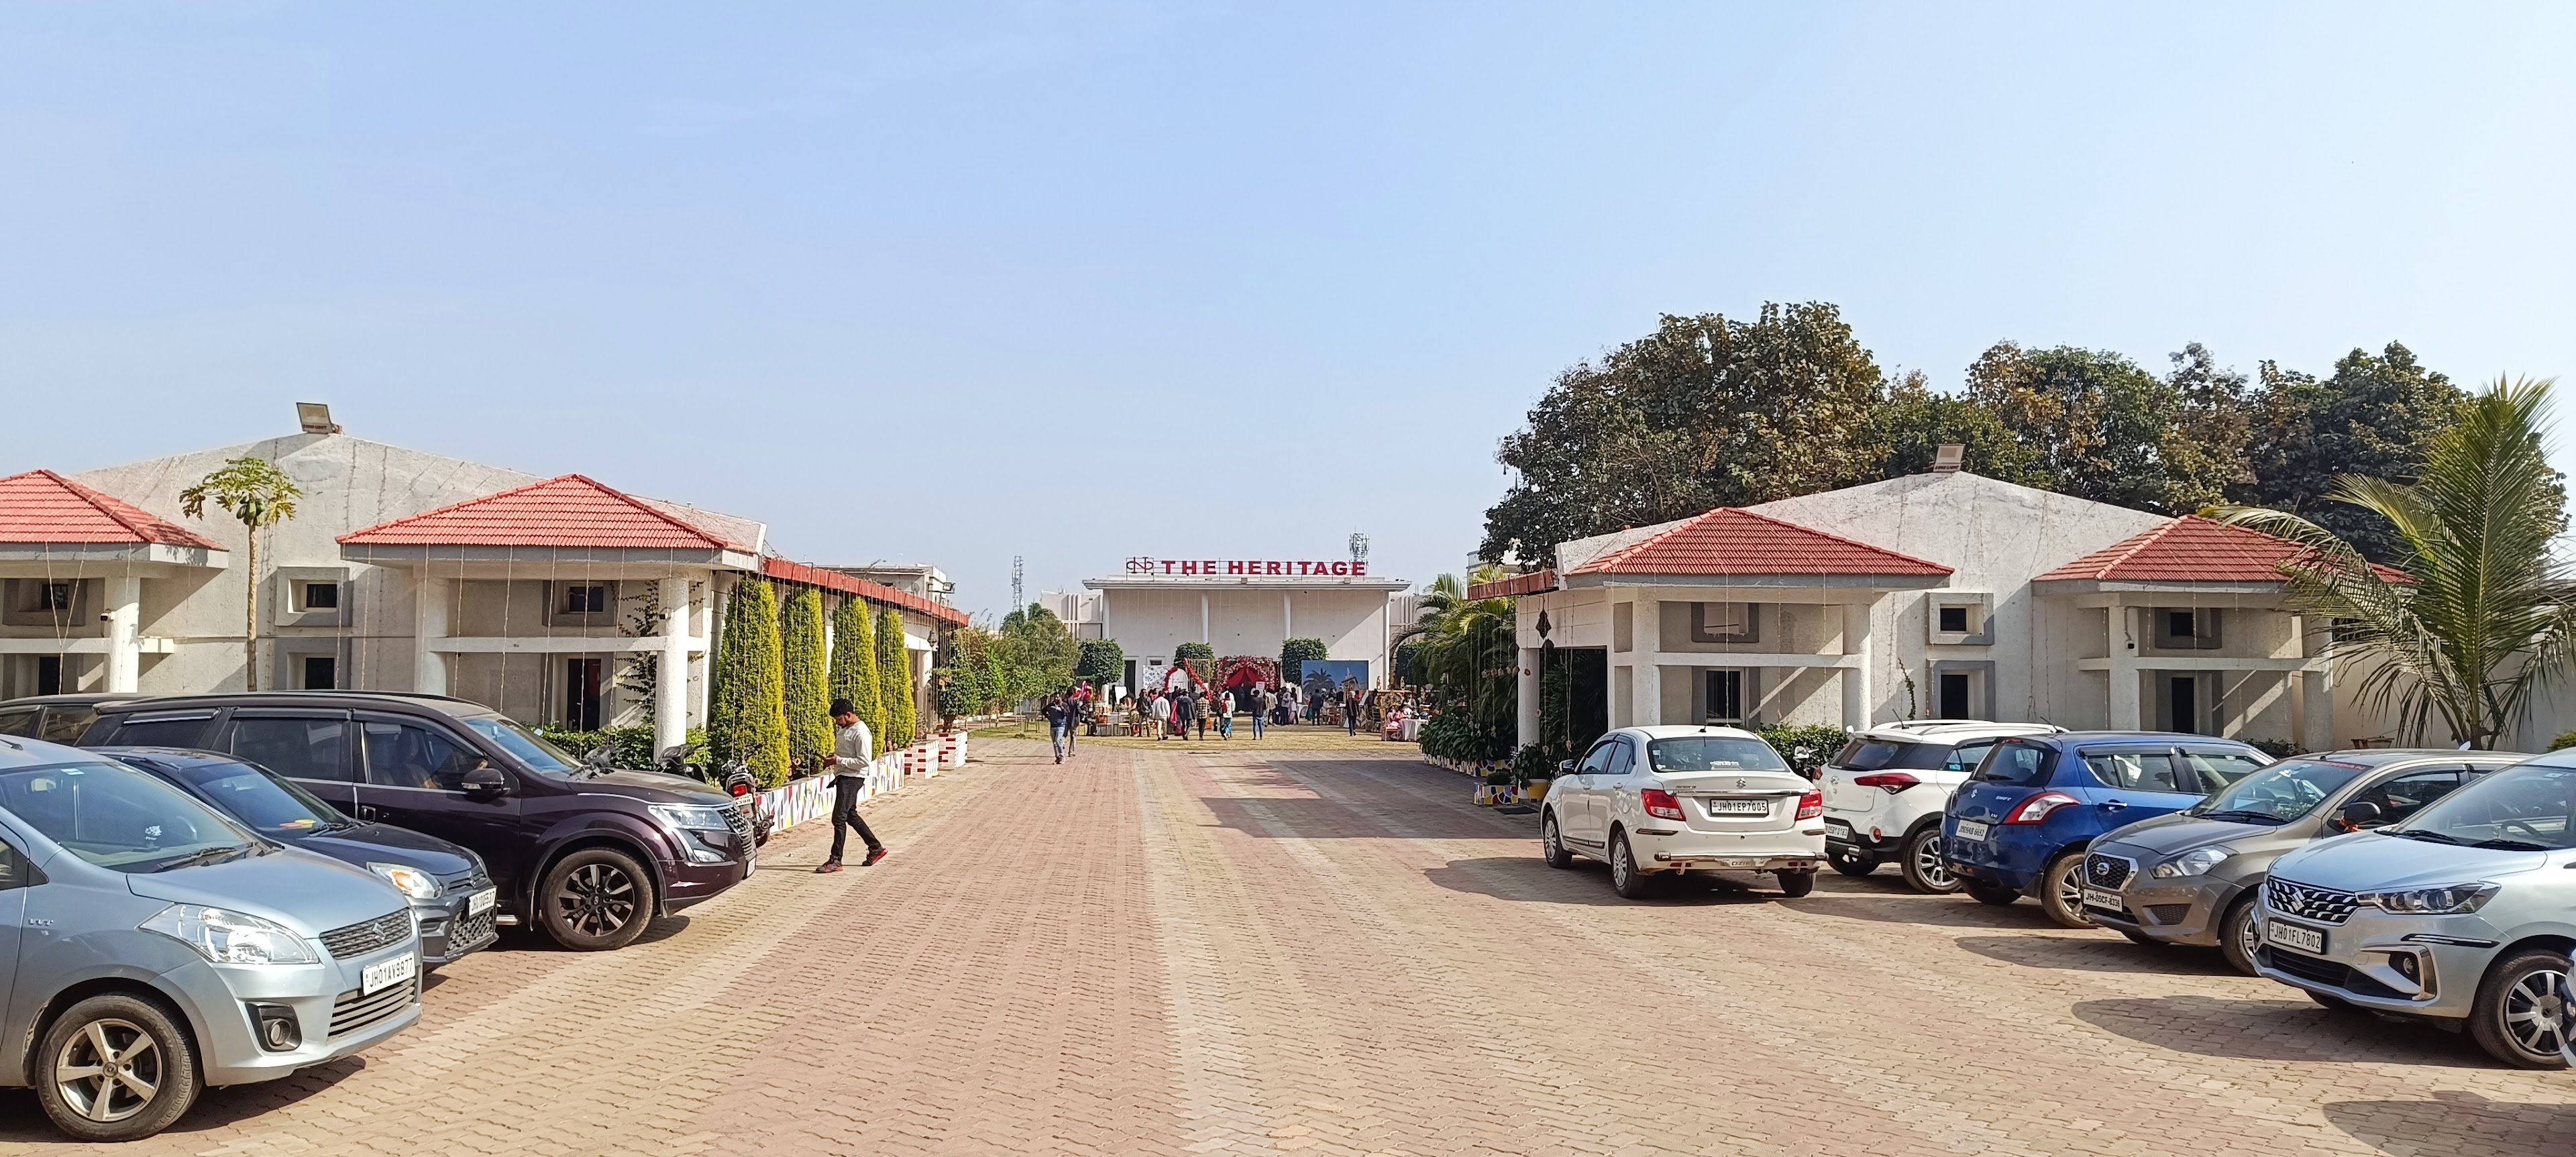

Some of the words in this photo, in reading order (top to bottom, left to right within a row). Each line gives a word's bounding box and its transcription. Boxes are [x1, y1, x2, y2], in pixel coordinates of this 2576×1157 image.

[1161, 561, 1216, 574] THE
[1228, 561, 1365, 575] HERITAGE
[1718, 802, 1766, 812] JH01EP7005
[2274, 925, 2320, 949] JH01FL7802
[370, 957, 413, 987] JH01AV9877
